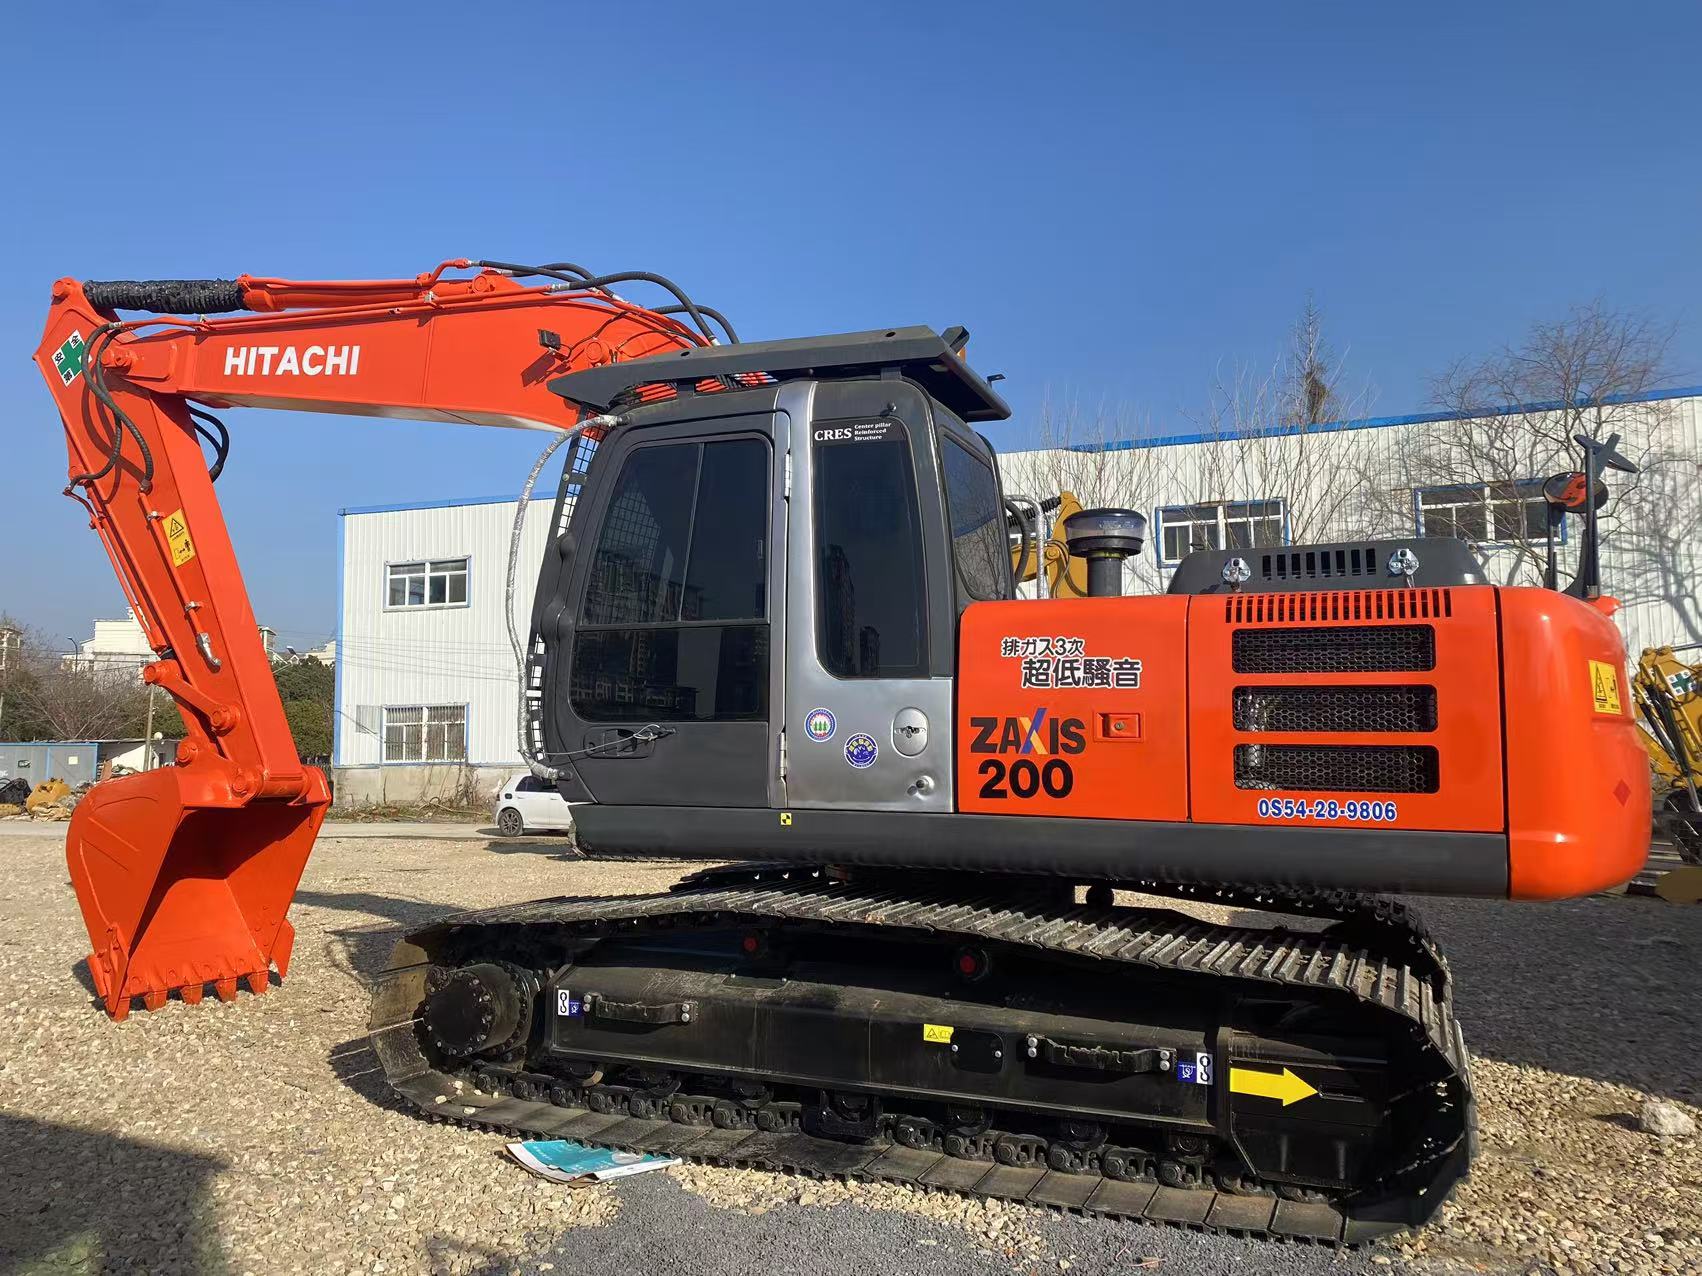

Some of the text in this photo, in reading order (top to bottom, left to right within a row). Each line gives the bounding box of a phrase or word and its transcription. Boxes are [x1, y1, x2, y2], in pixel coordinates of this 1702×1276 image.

[223, 345, 361, 376] HITACHI
[814, 428, 852, 441] CRES
[1002, 637, 1084, 656] 排ガス3次
[1022, 657, 1141, 688] 超低騒音
[970, 708, 1086, 754] ZAXIS
[978, 759, 1073, 798] 200
